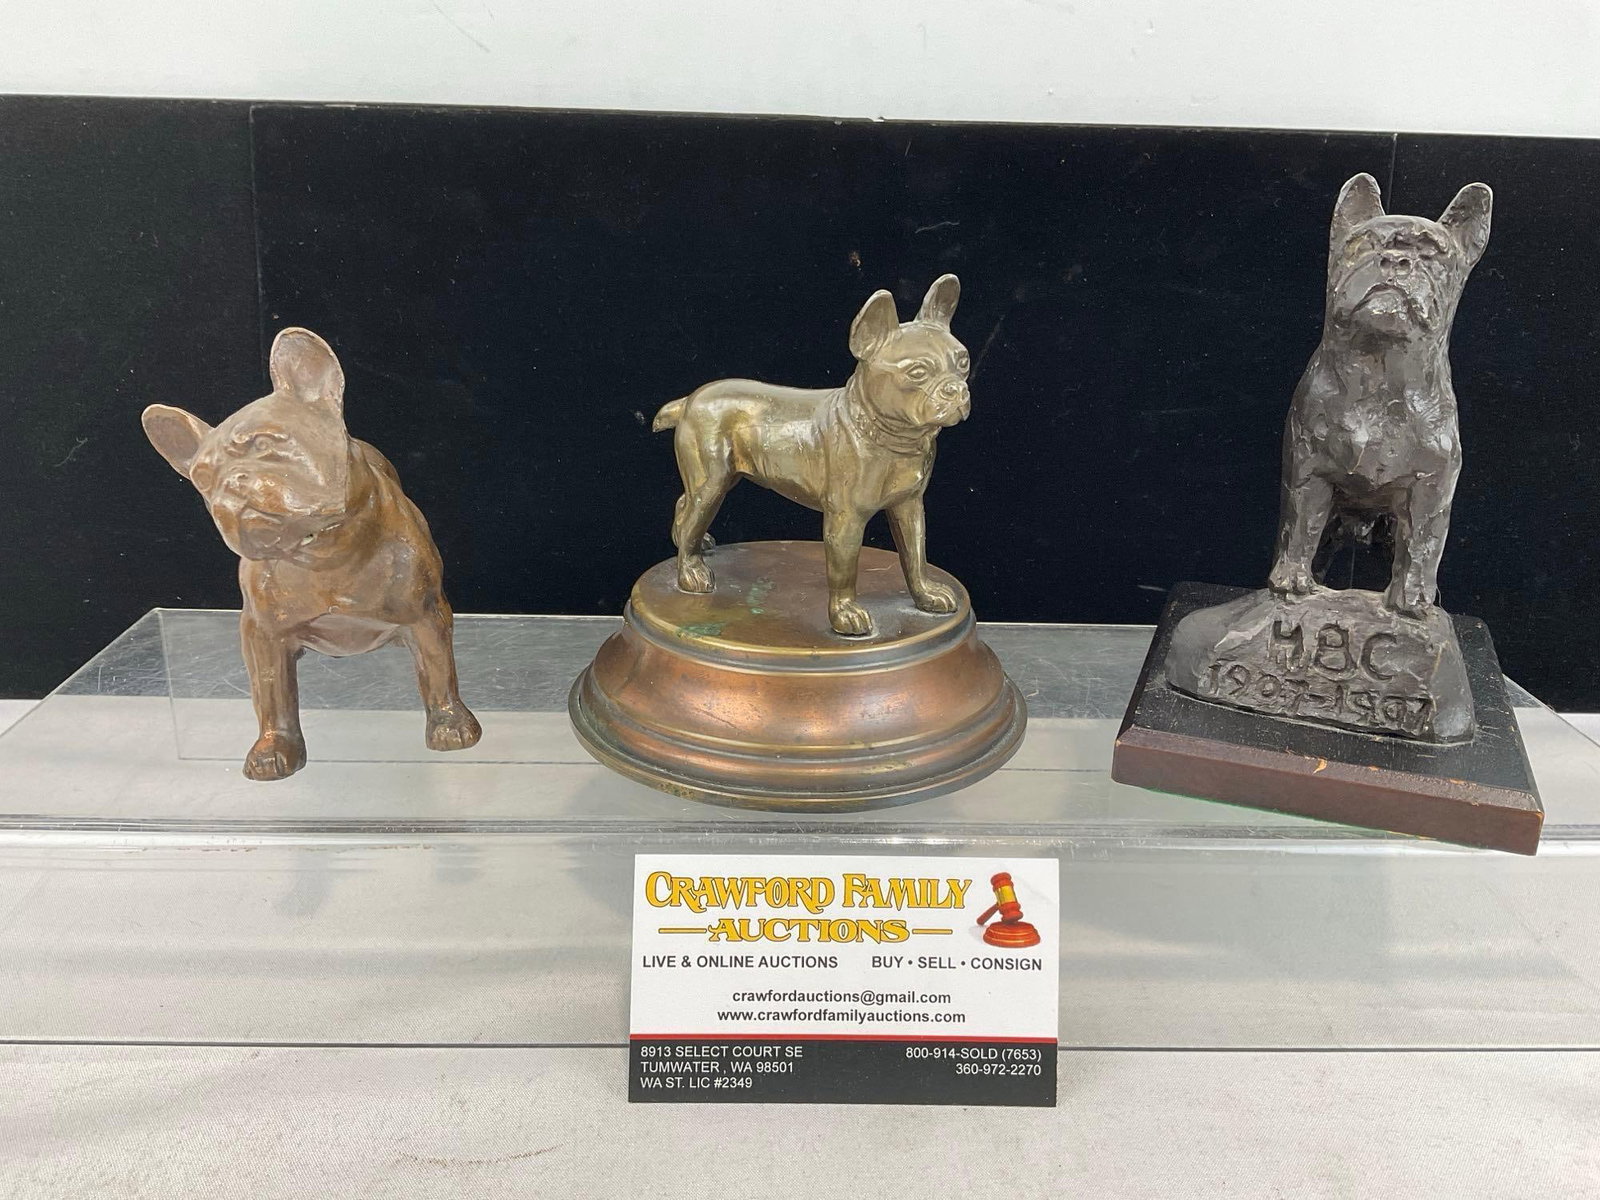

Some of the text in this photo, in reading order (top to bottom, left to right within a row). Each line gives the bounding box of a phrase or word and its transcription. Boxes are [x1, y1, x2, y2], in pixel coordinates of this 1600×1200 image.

[645, 871, 972, 914] CRAWFORD FAMILY
[708, 918, 910, 944] AUCTIONS
[642, 955, 839, 969] LIVE & ONLINE AUCTIONS
[871, 955, 1042, 971] BUY SELL CONSIGN
[732, 989, 951, 1006] crawfordauctions@gmail.com
[717, 1008, 966, 1025] www.crawfordfamilyauctions.com
[640, 1045, 803, 1058] 8913 SELECT COURT SE
[905, 1046, 1042, 1063] 800-914-SOLD (7653)
[730, 1061, 753, 1073] WA
[756, 1061, 793, 1073] 98501
[955, 1062, 1042, 1076] 360-972-2270
[639, 1076, 753, 1089] WA ST. LIC #2349
